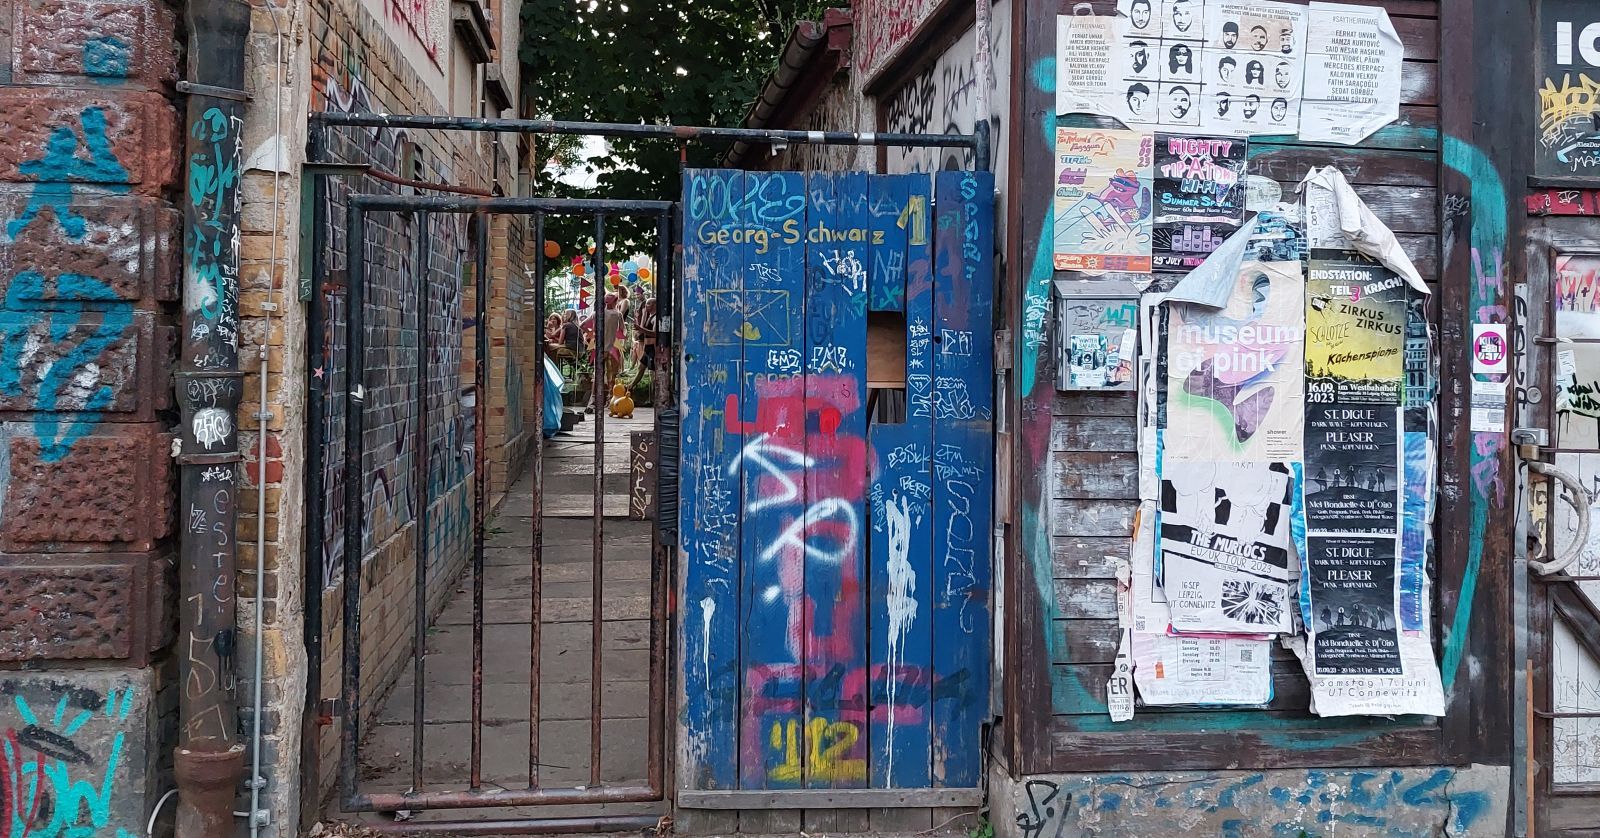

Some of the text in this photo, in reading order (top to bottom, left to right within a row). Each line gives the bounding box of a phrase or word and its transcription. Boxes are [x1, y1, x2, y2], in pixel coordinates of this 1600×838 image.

[1358, 31, 1377, 39] UNVAR
[1331, 38, 1351, 46] HAMZA
[1340, 46, 1359, 54] NESAR
[1324, 62, 1355, 71] MERCEDES
[1356, 72, 1378, 80] VELKOV
[1168, 137, 1232, 157] MIGHTY
[1161, 192, 1199, 207] SUMMER
[1166, 256, 1182, 266] JULY
[1311, 270, 1373, 281] ENDSTATION:
[1330, 285, 1351, 296] TEIL
[1340, 304, 1384, 320] ZIRKUS
[1356, 318, 1401, 335] ZIRKUS
[1176, 323, 1298, 346] museum
[1213, 347, 1275, 381] pink
[1307, 382, 1335, 394] 16.09.
[1350, 382, 1397, 392] Westbahnhof
[1307, 393, 1335, 403] 2023
[1324, 409, 1375, 419] ST. DIGUE
[1326, 432, 1374, 443] PLEASER
[1190, 530, 1267, 560] THE MURLOCS
[1326, 548, 1374, 558] ST. DIGUE
[1191, 546, 1272, 575] EU/UK TOUR 2023
[1328, 570, 1372, 581] PLEASER
[1178, 590, 1202, 599] LEIPZIG
[1179, 600, 1216, 609] CONNEWITZ
[1328, 688, 1418, 697] UT Connewitz
